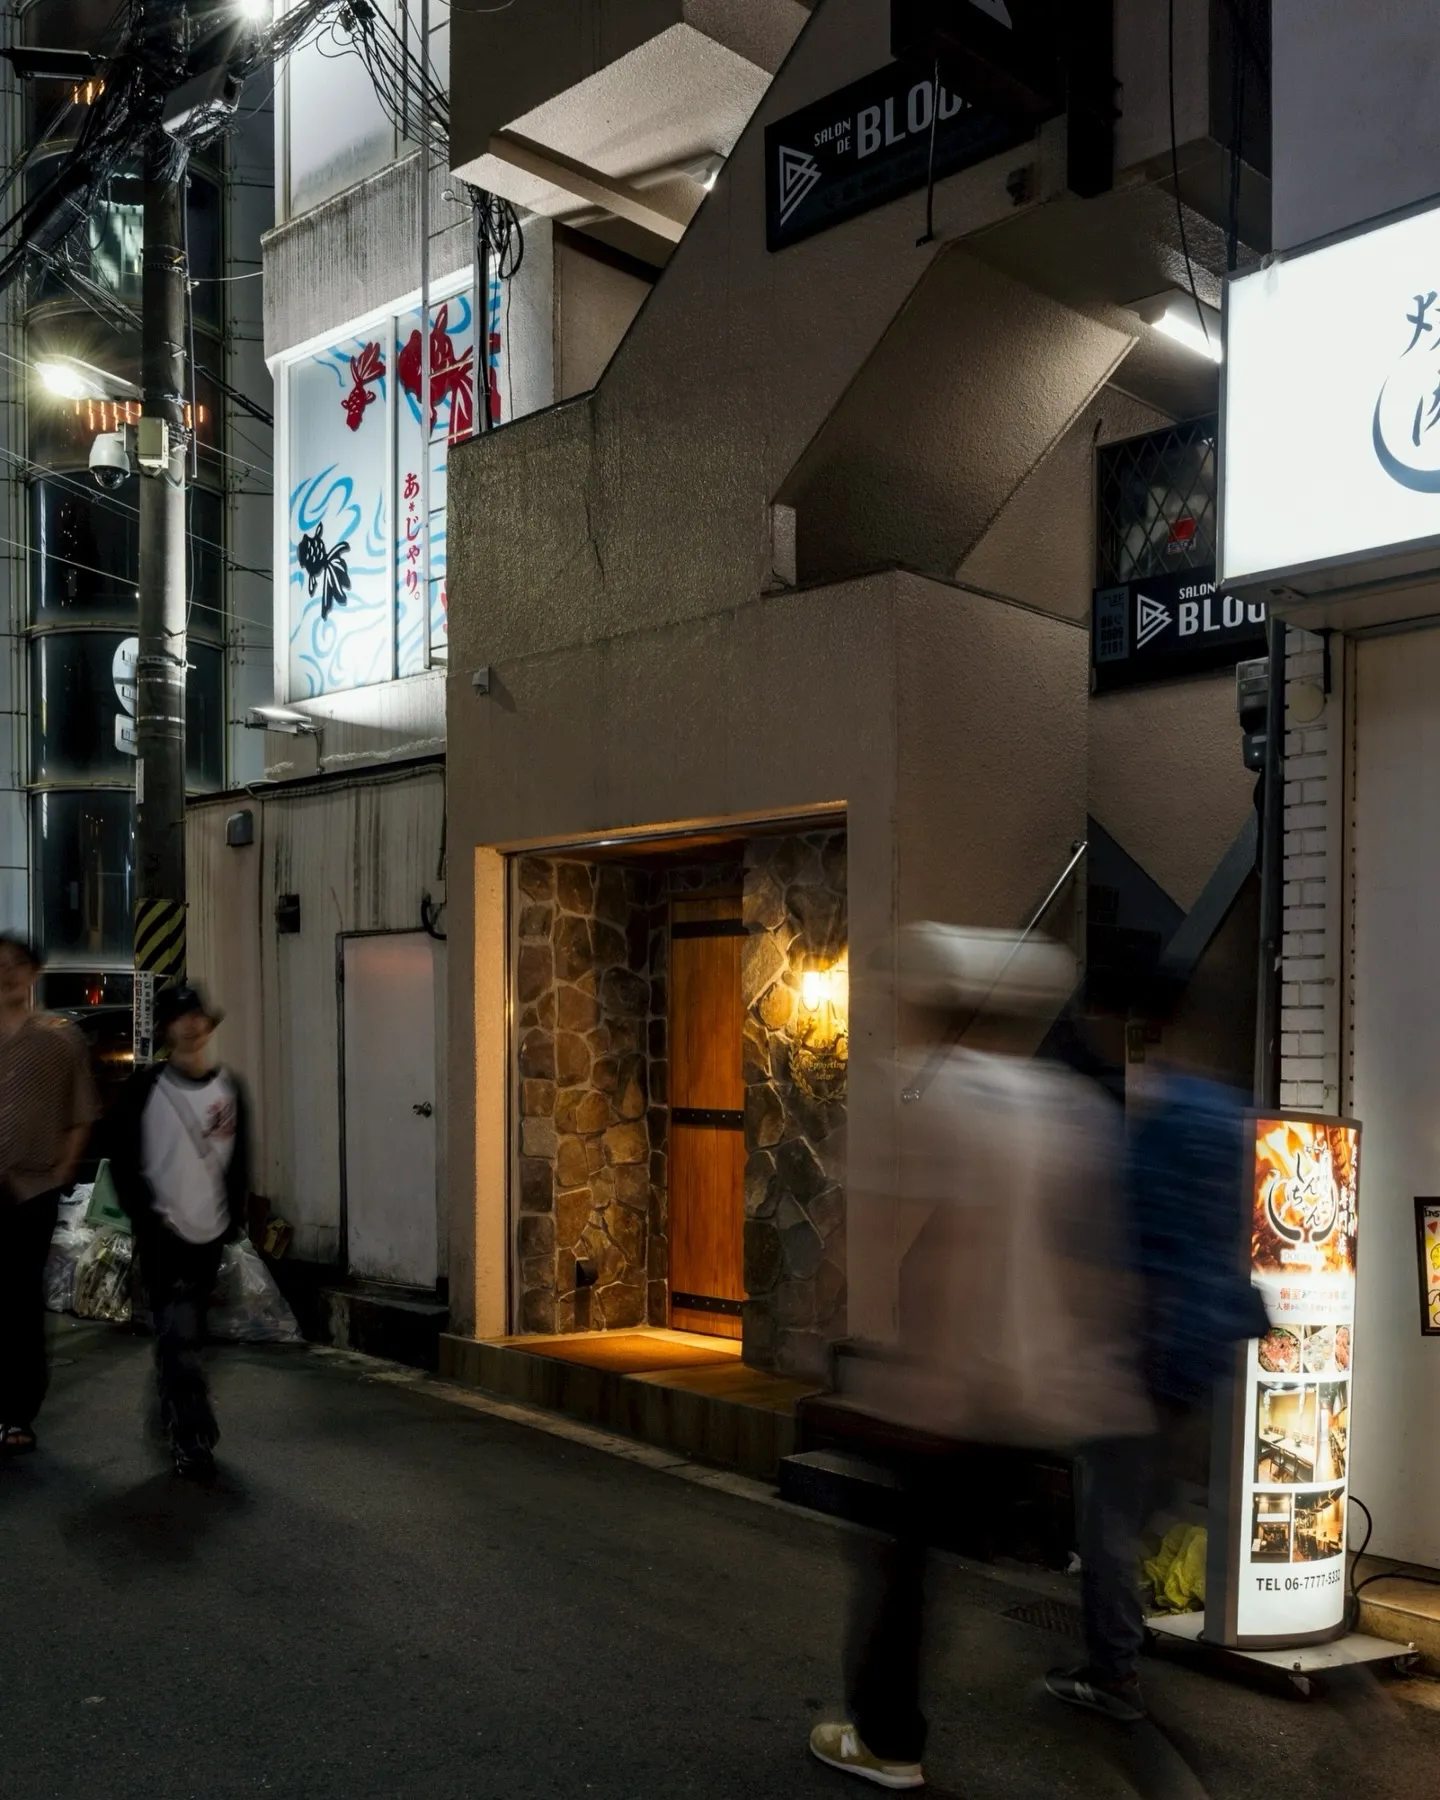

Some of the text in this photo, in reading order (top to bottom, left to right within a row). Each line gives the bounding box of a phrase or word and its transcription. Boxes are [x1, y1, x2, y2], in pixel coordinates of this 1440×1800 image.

[813, 116, 852, 148] SALON
[836, 136, 852, 156] DE
[1178, 581, 1217, 600] SALON
[1423, 1206, 1440, 1218] Ins
[1256, 1577, 1281, 1592] TEL
